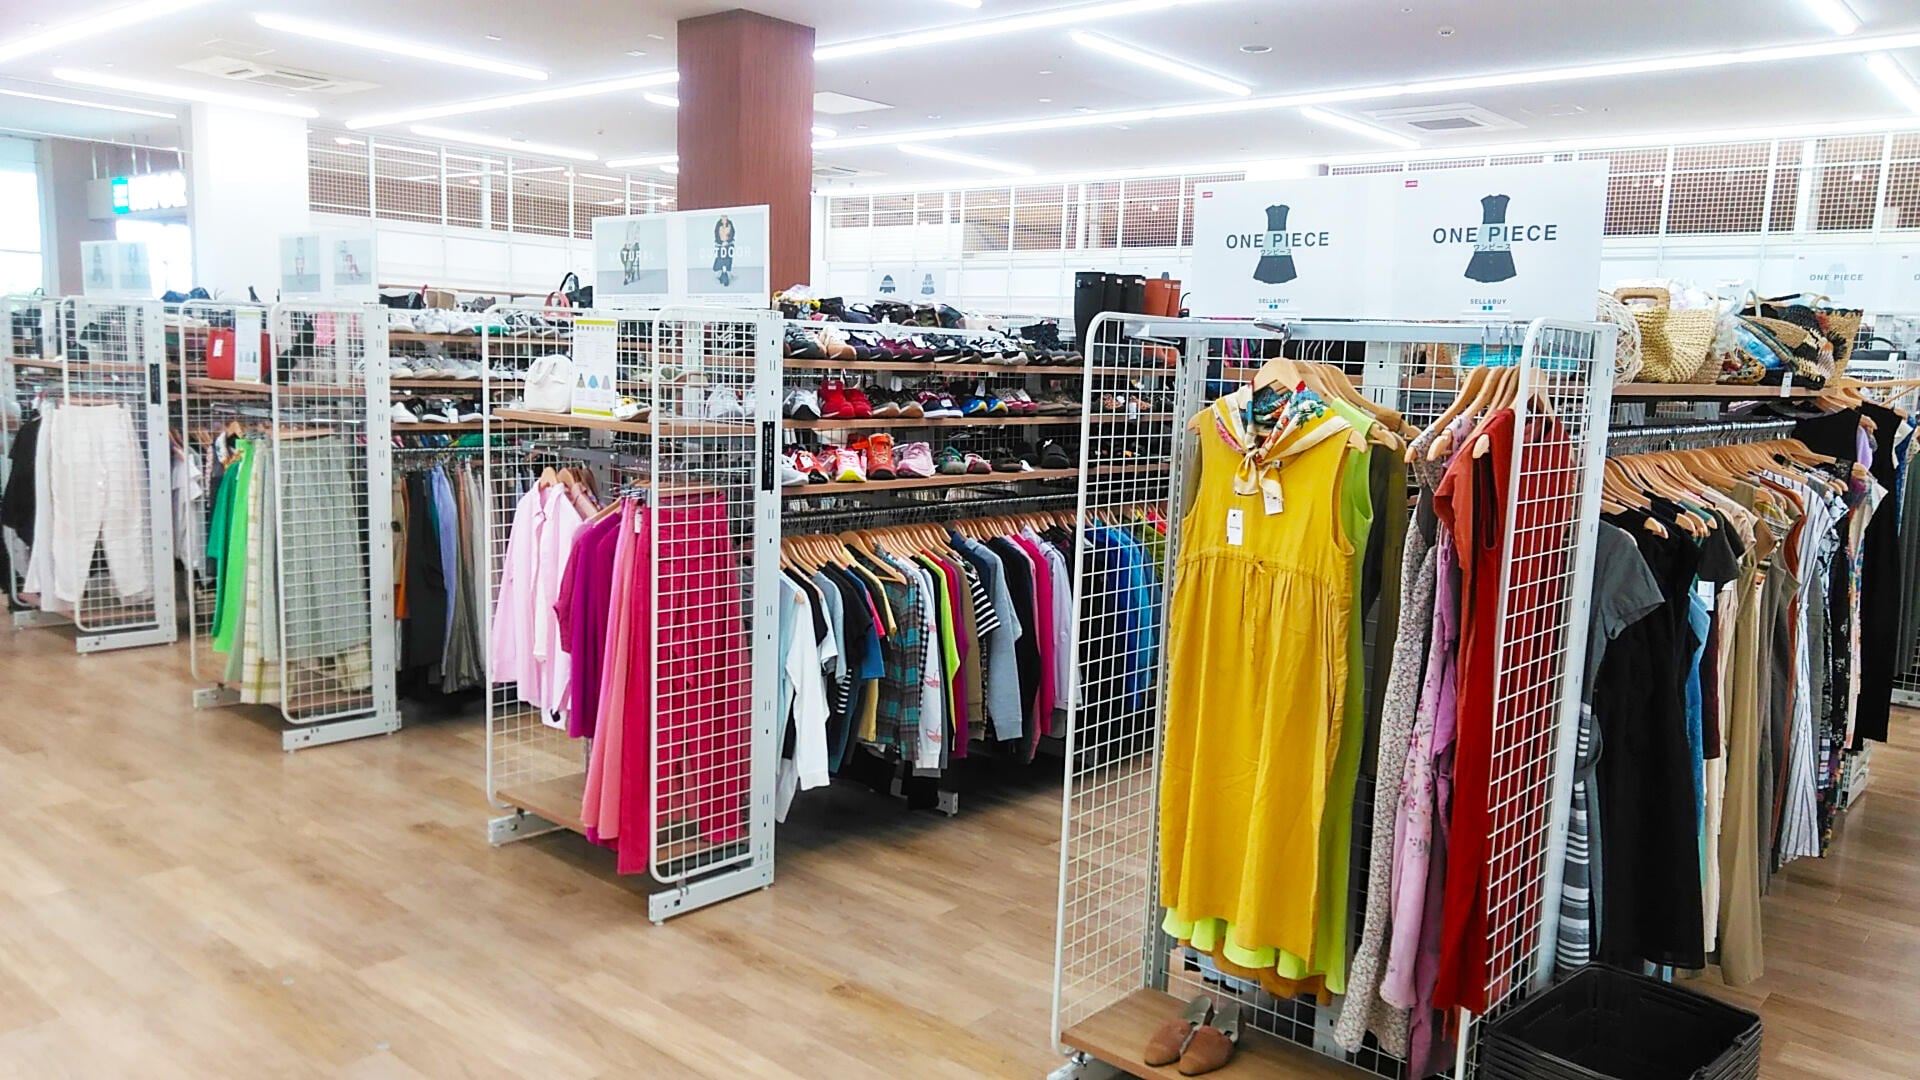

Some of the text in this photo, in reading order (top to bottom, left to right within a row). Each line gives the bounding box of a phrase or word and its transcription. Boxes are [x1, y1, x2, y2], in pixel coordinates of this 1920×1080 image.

[1226, 232, 1329, 248] ONE PIECE
[1433, 225, 1558, 243] ONE PIECE
[699, 246, 752, 259] OUTDOOR
[1473, 243, 1511, 251] ワンピース
[1833, 273, 1864, 281] PIECE
